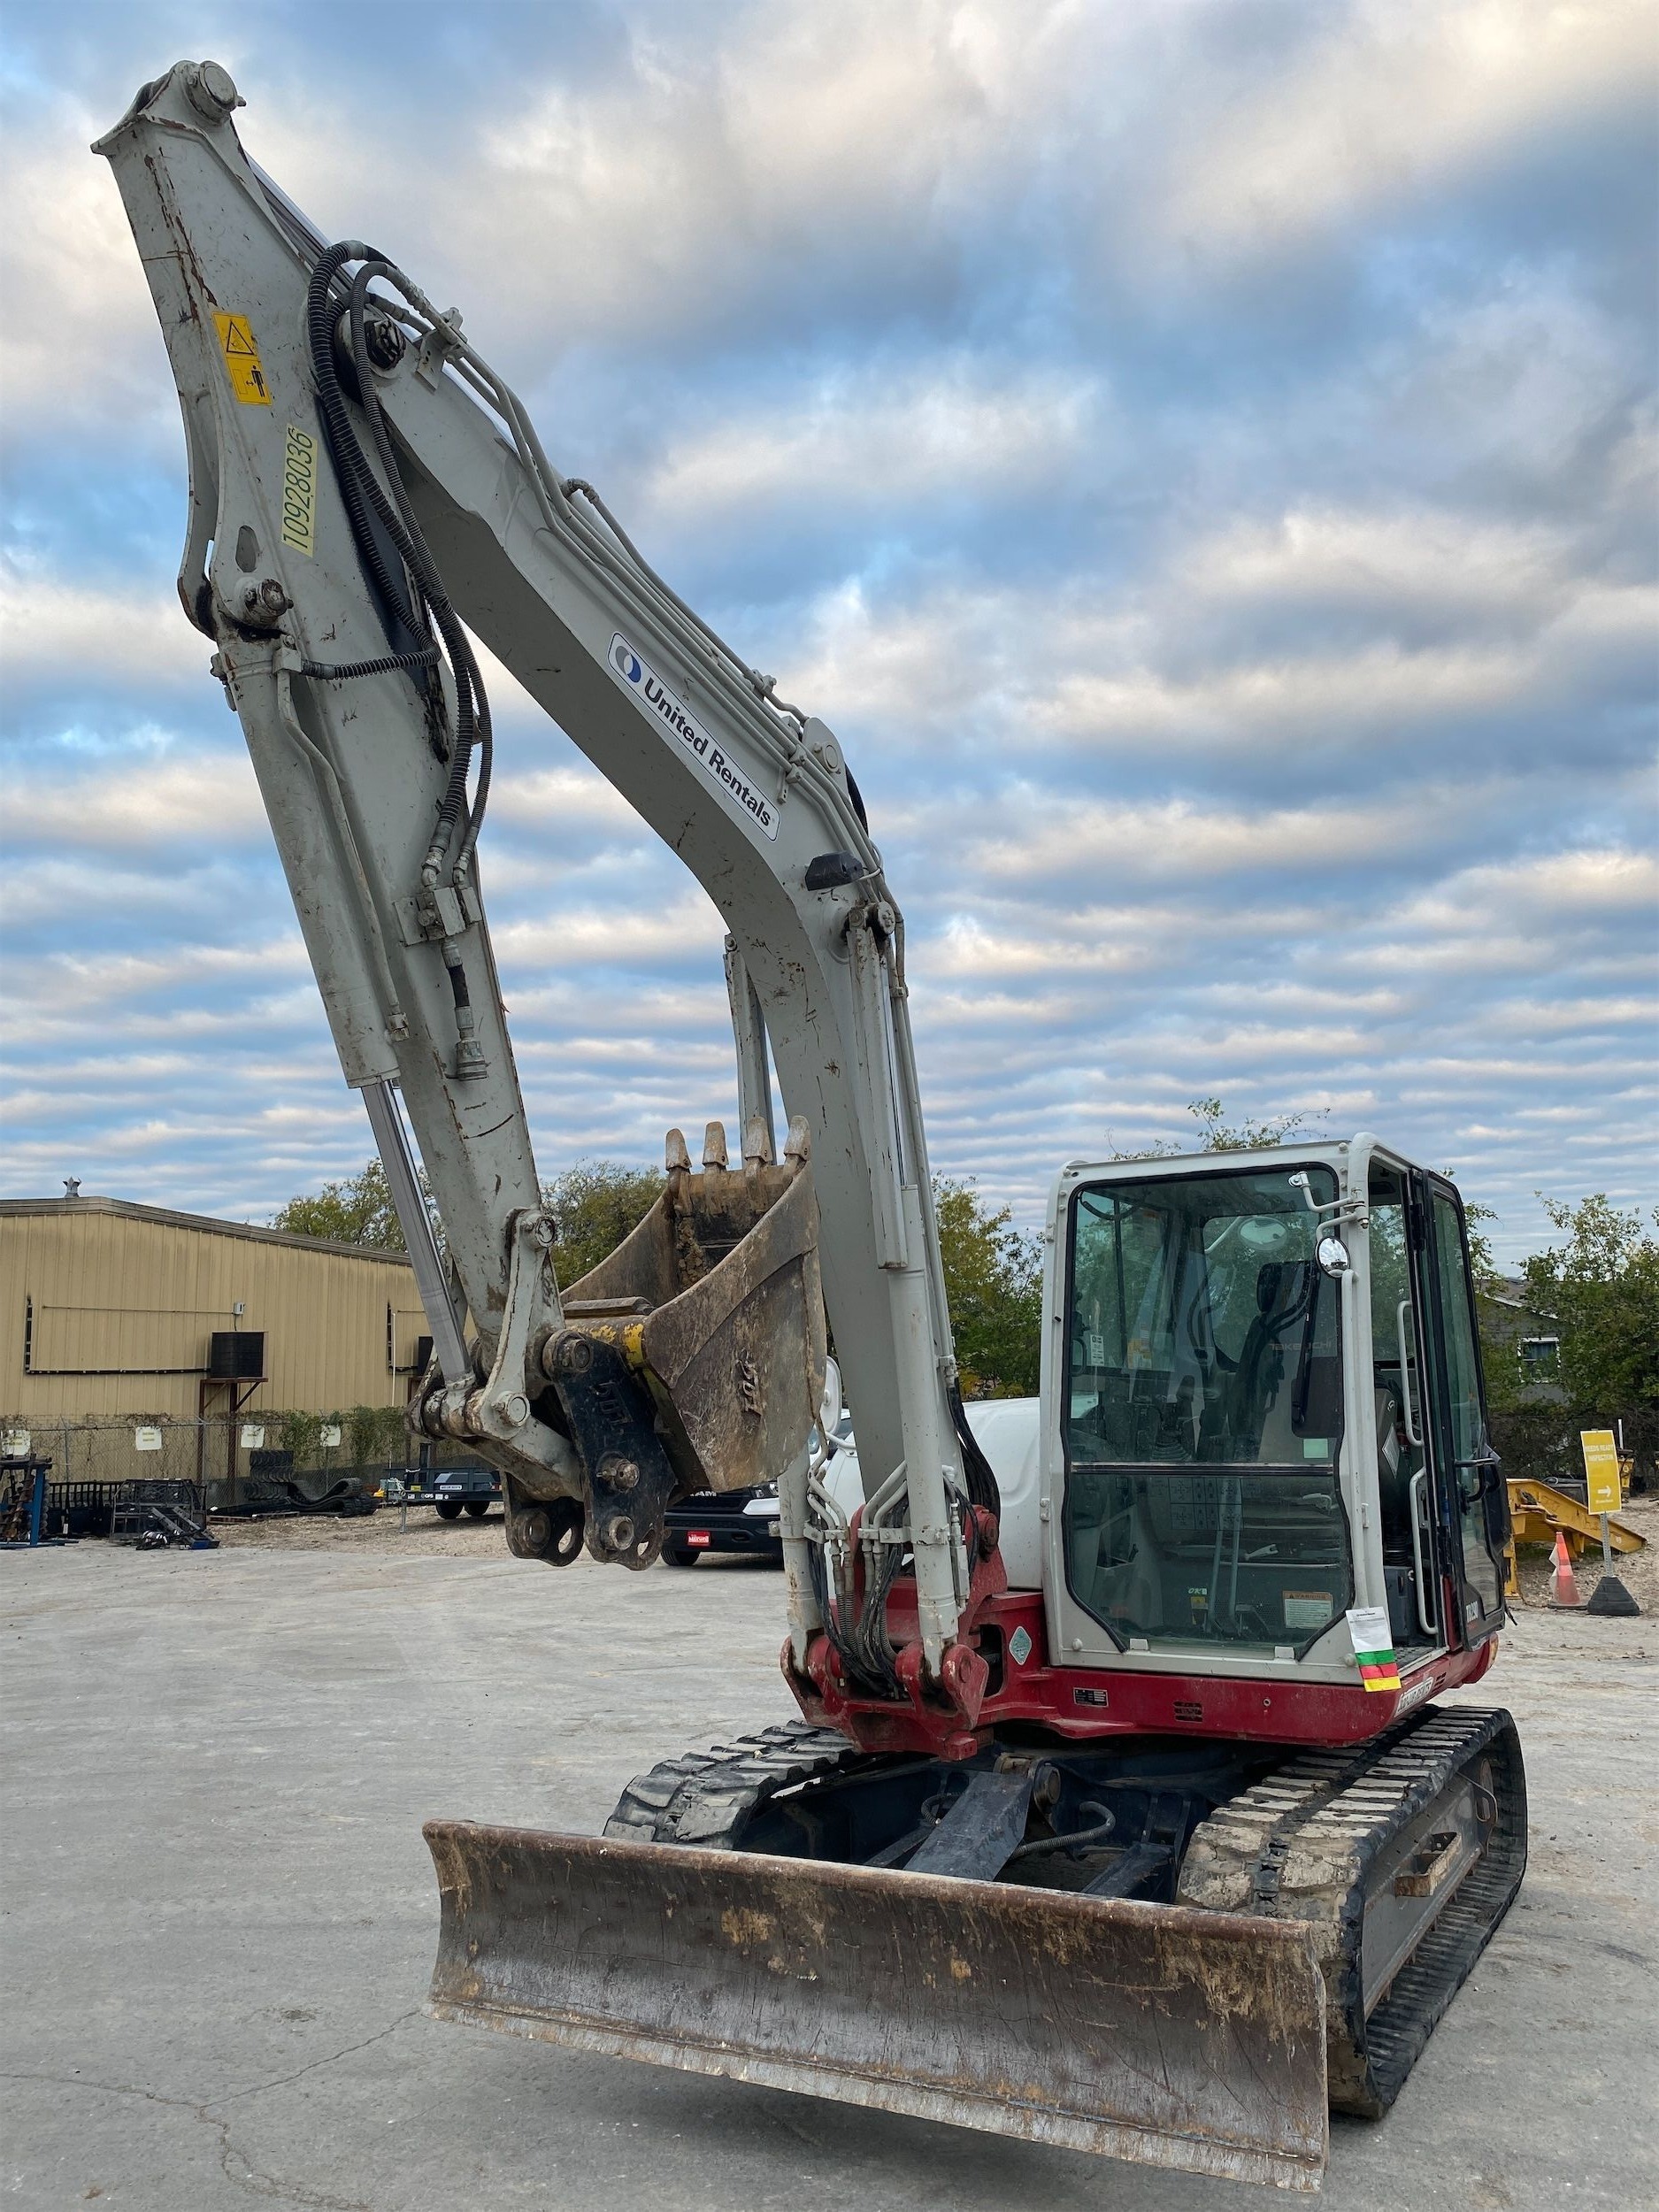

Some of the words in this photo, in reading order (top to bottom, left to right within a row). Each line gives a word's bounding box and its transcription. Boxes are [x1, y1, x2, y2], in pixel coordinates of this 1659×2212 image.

[282, 426, 313, 549] 10928036
[644, 677, 709, 757] United
[709, 749, 772, 826] Rentals
